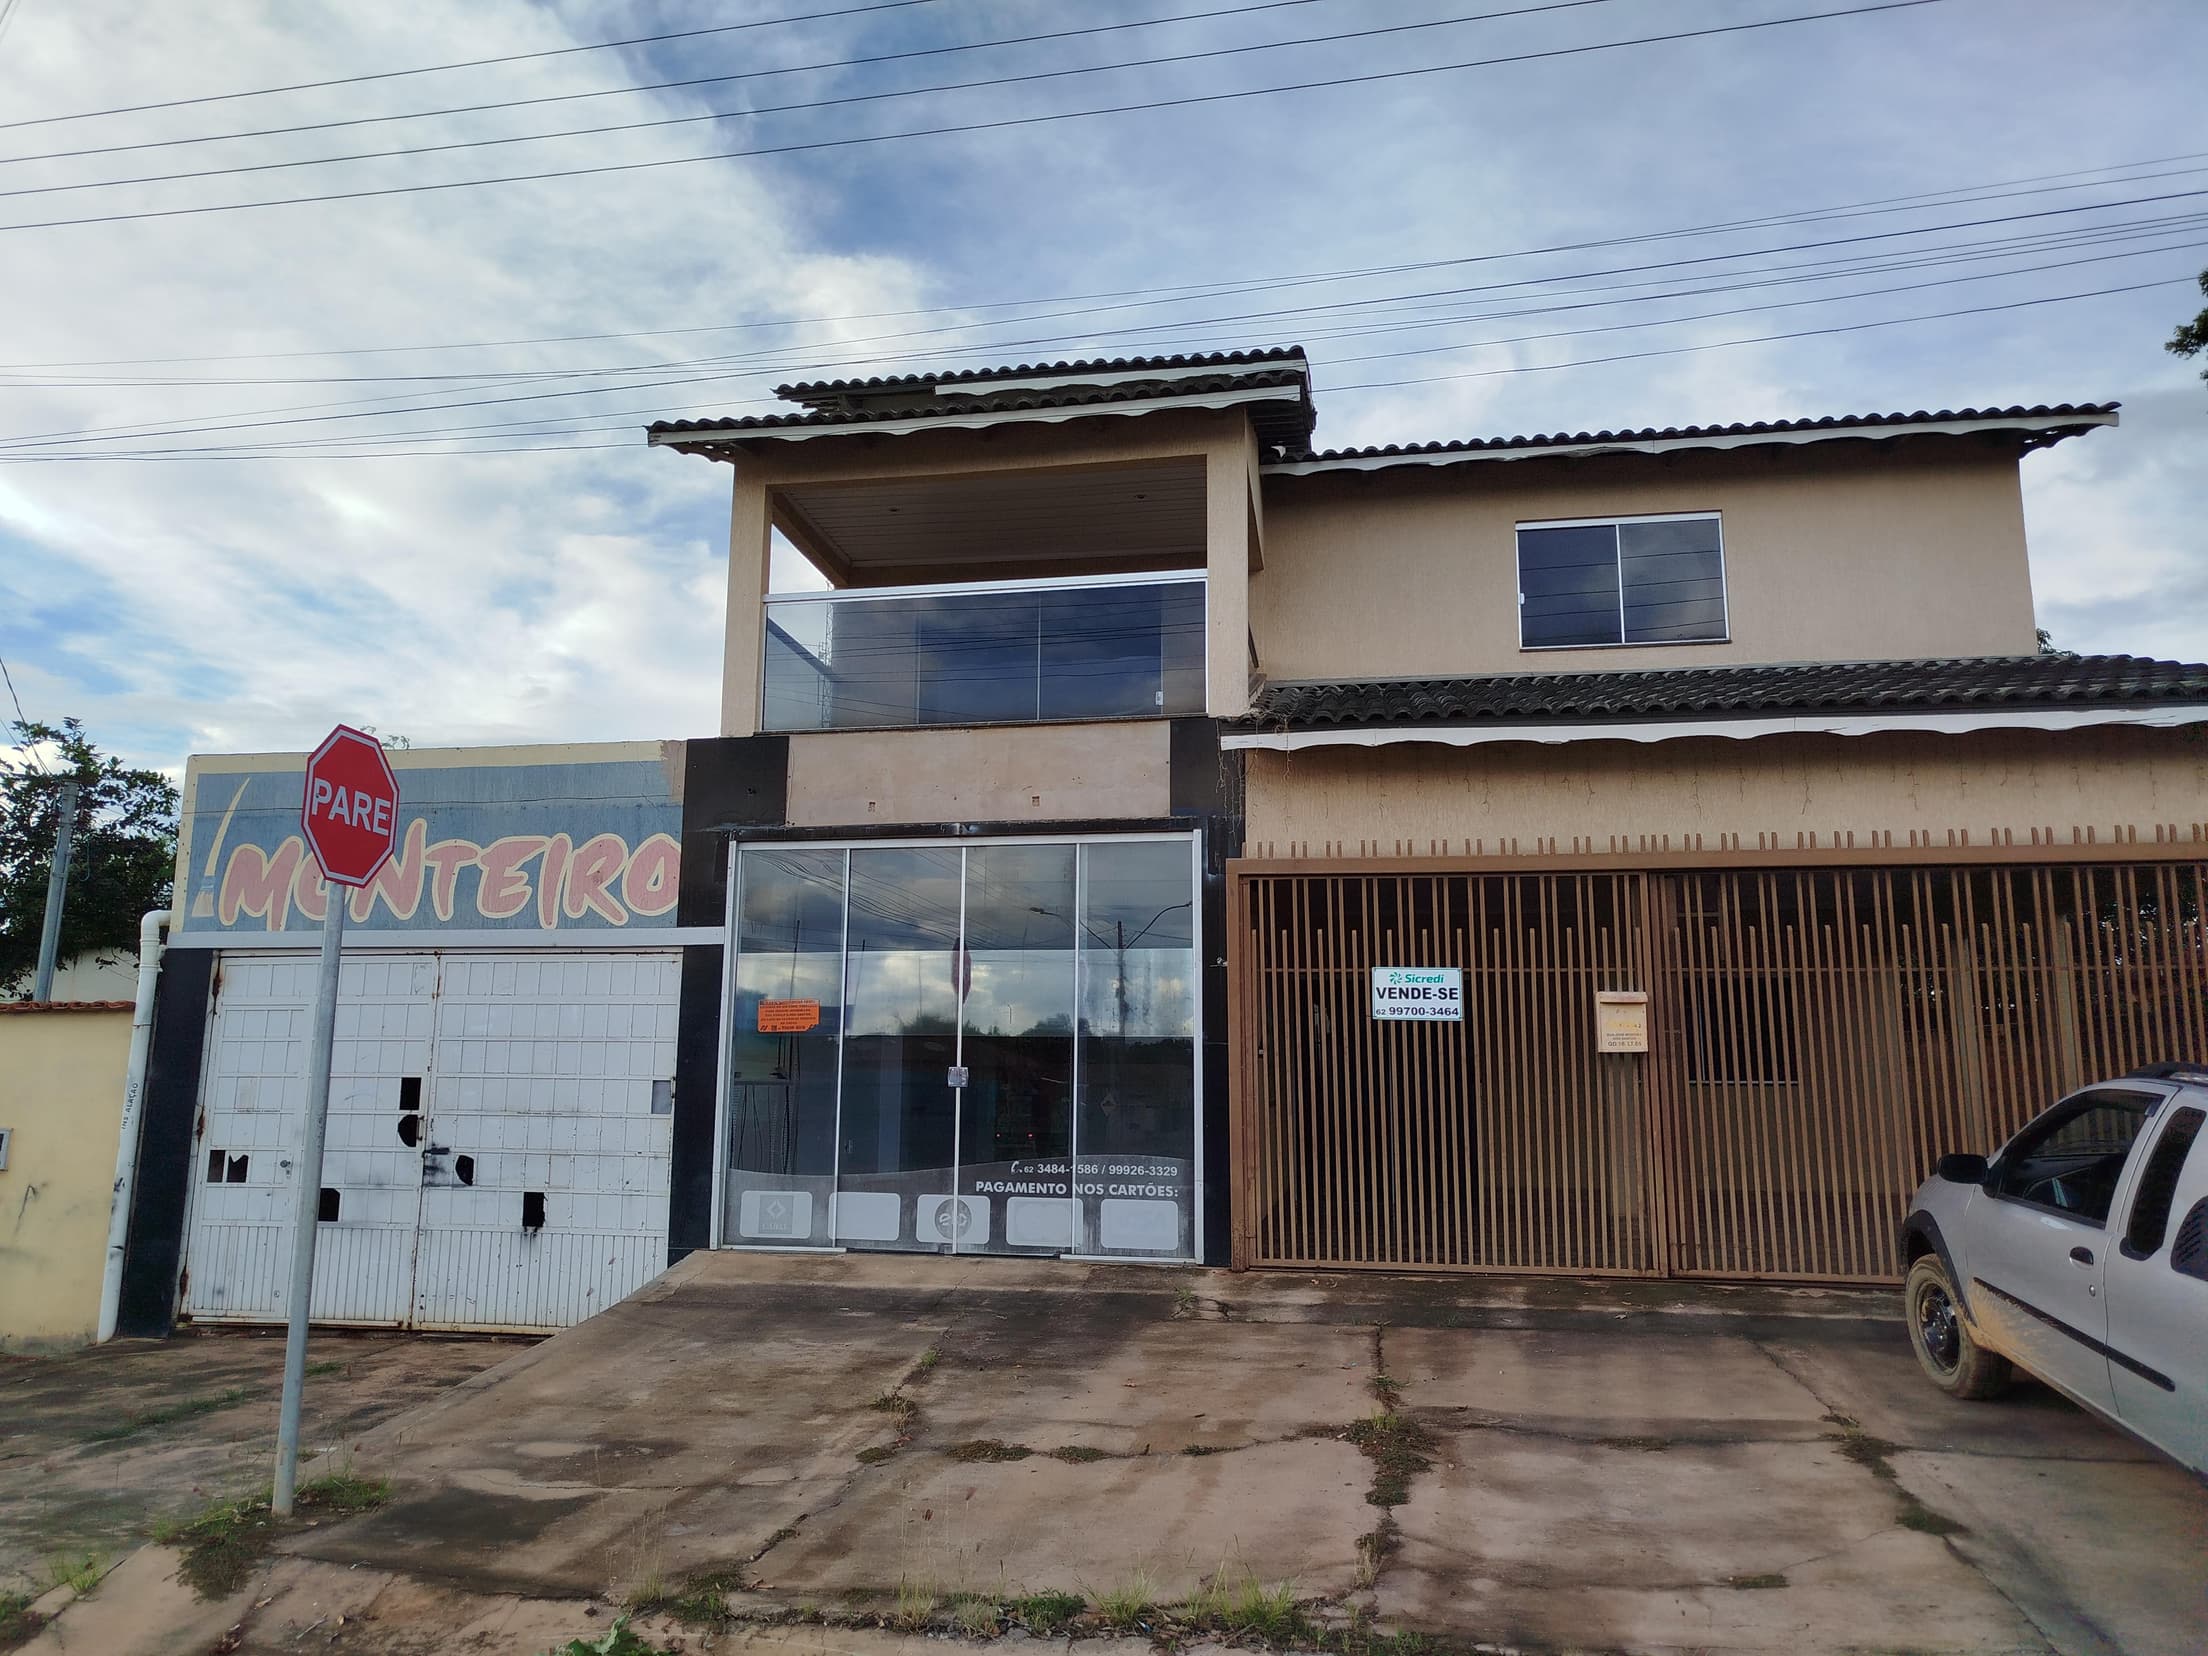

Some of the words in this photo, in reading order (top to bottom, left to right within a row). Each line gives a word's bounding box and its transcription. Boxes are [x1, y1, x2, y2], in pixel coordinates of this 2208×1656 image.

[312, 778, 391, 836] PARE
[1405, 974, 1444, 983] Sicredi
[1376, 987, 1459, 1000] VENDE-SE
[1376, 1008, 1386, 1016] 62
[1388, 1007, 1459, 1016] 99700-3464
[1037, 1163, 1098, 1175] 3484-586
[1108, 1164, 1178, 1177] 99926-3329
[975, 1181, 1067, 1195] PAGAMENTO
[1073, 1183, 1104, 1195] NOS
[1108, 1182, 1179, 1198] CARTÕES:
[939, 1210, 968, 1227] eo
